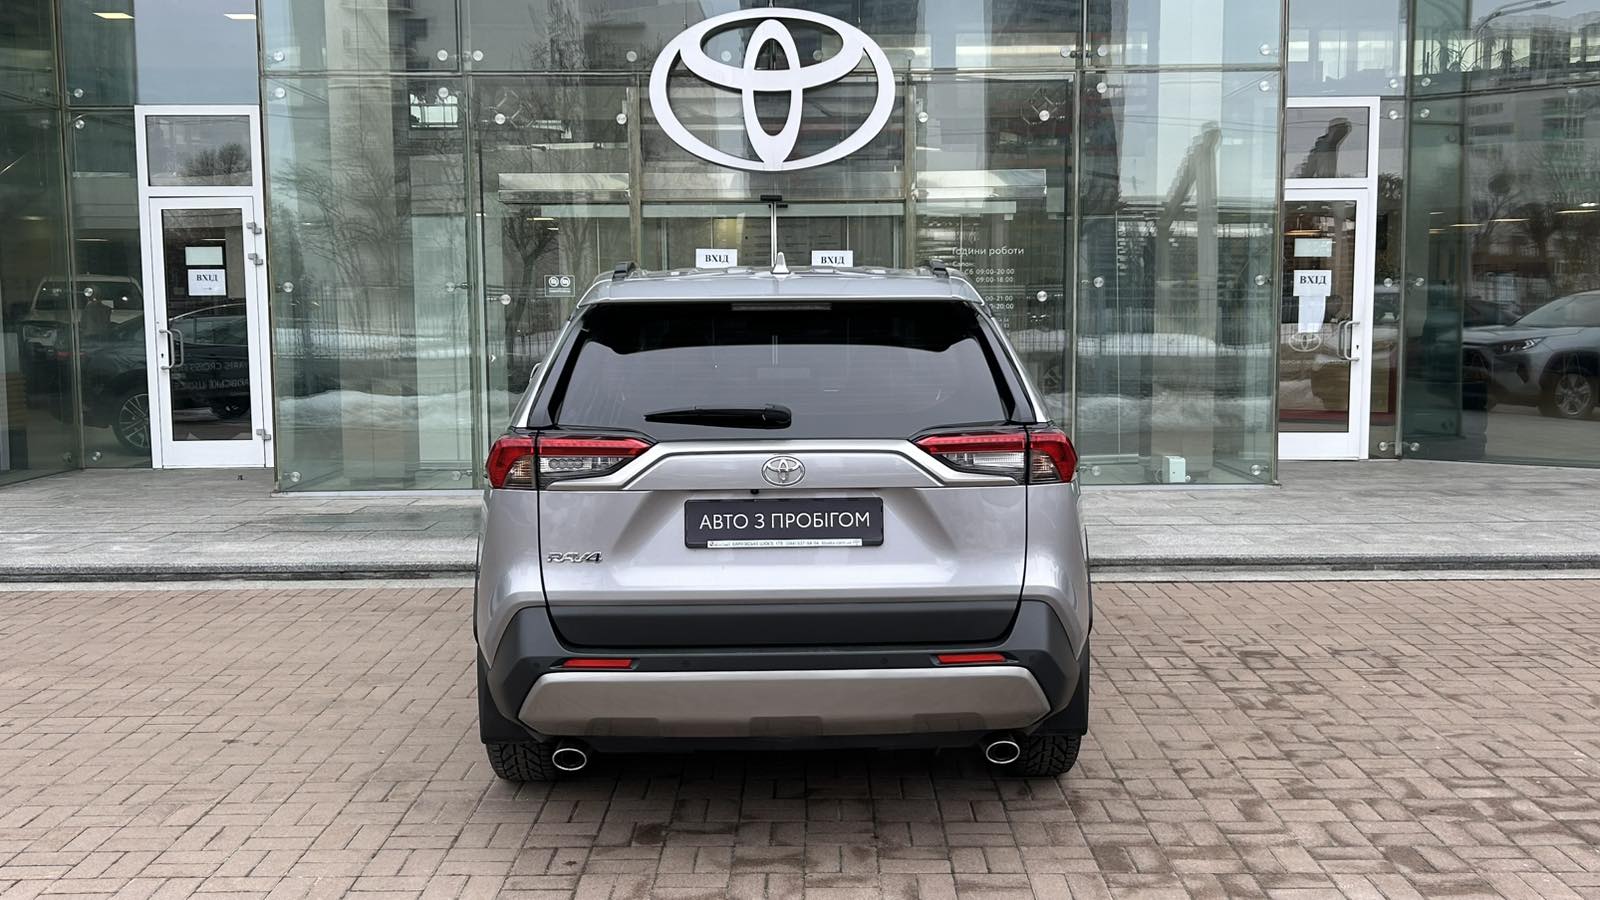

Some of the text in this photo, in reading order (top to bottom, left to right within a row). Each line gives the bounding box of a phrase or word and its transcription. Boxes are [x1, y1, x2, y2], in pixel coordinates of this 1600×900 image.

[952, 245, 1025, 256] Години роботи
[705, 254, 729, 263] ВХІД
[820, 256, 846, 265] ВХІД
[1299, 275, 1328, 285] ВХІД
[699, 511, 870, 530] АВТО З ПРОБІГОМ
[547, 551, 603, 563] RAV4
